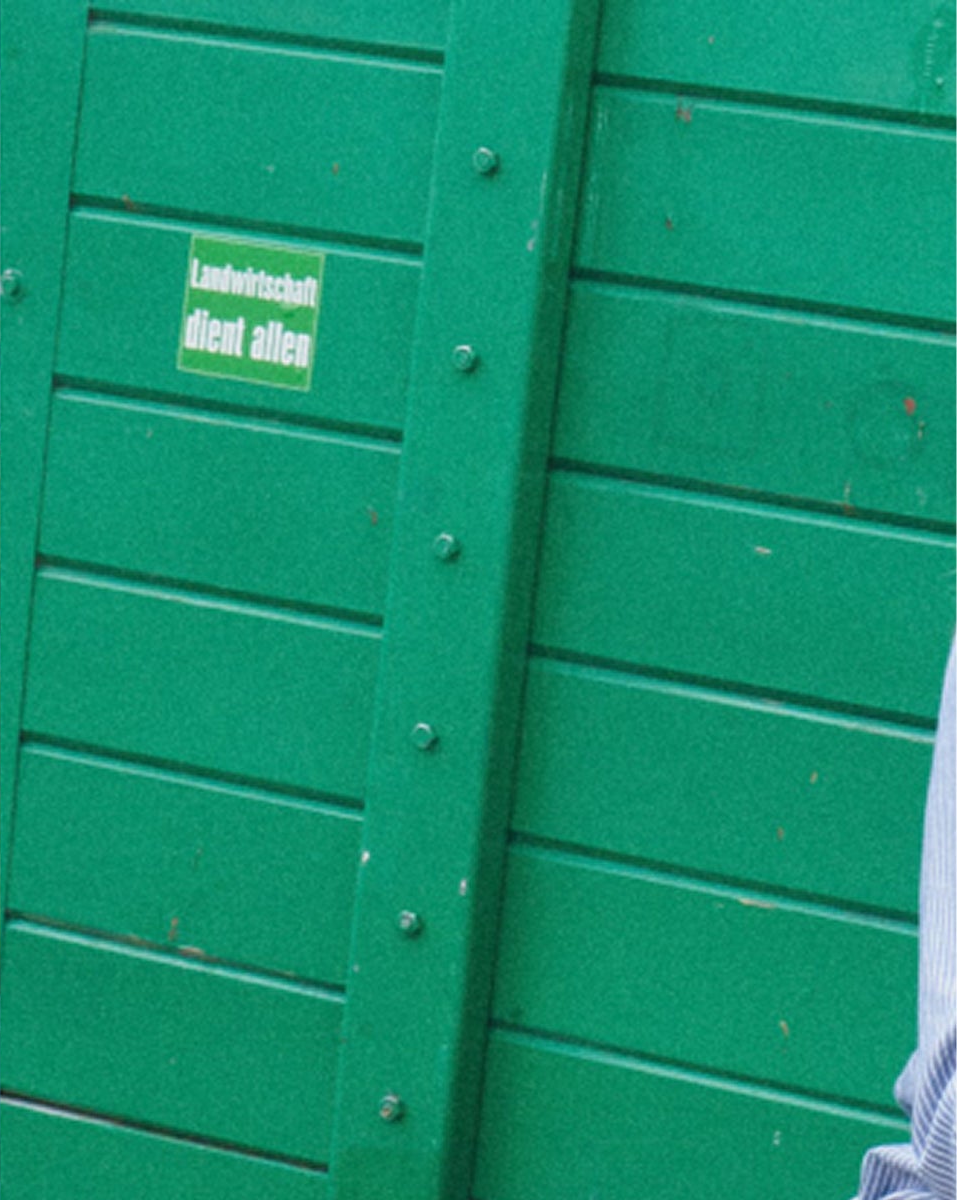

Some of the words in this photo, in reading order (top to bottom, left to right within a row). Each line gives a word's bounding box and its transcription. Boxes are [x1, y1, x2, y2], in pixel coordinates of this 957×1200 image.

[191, 258, 318, 308] Landwirtschaft
[184, 308, 245, 357] dient
[250, 321, 311, 368] allen
